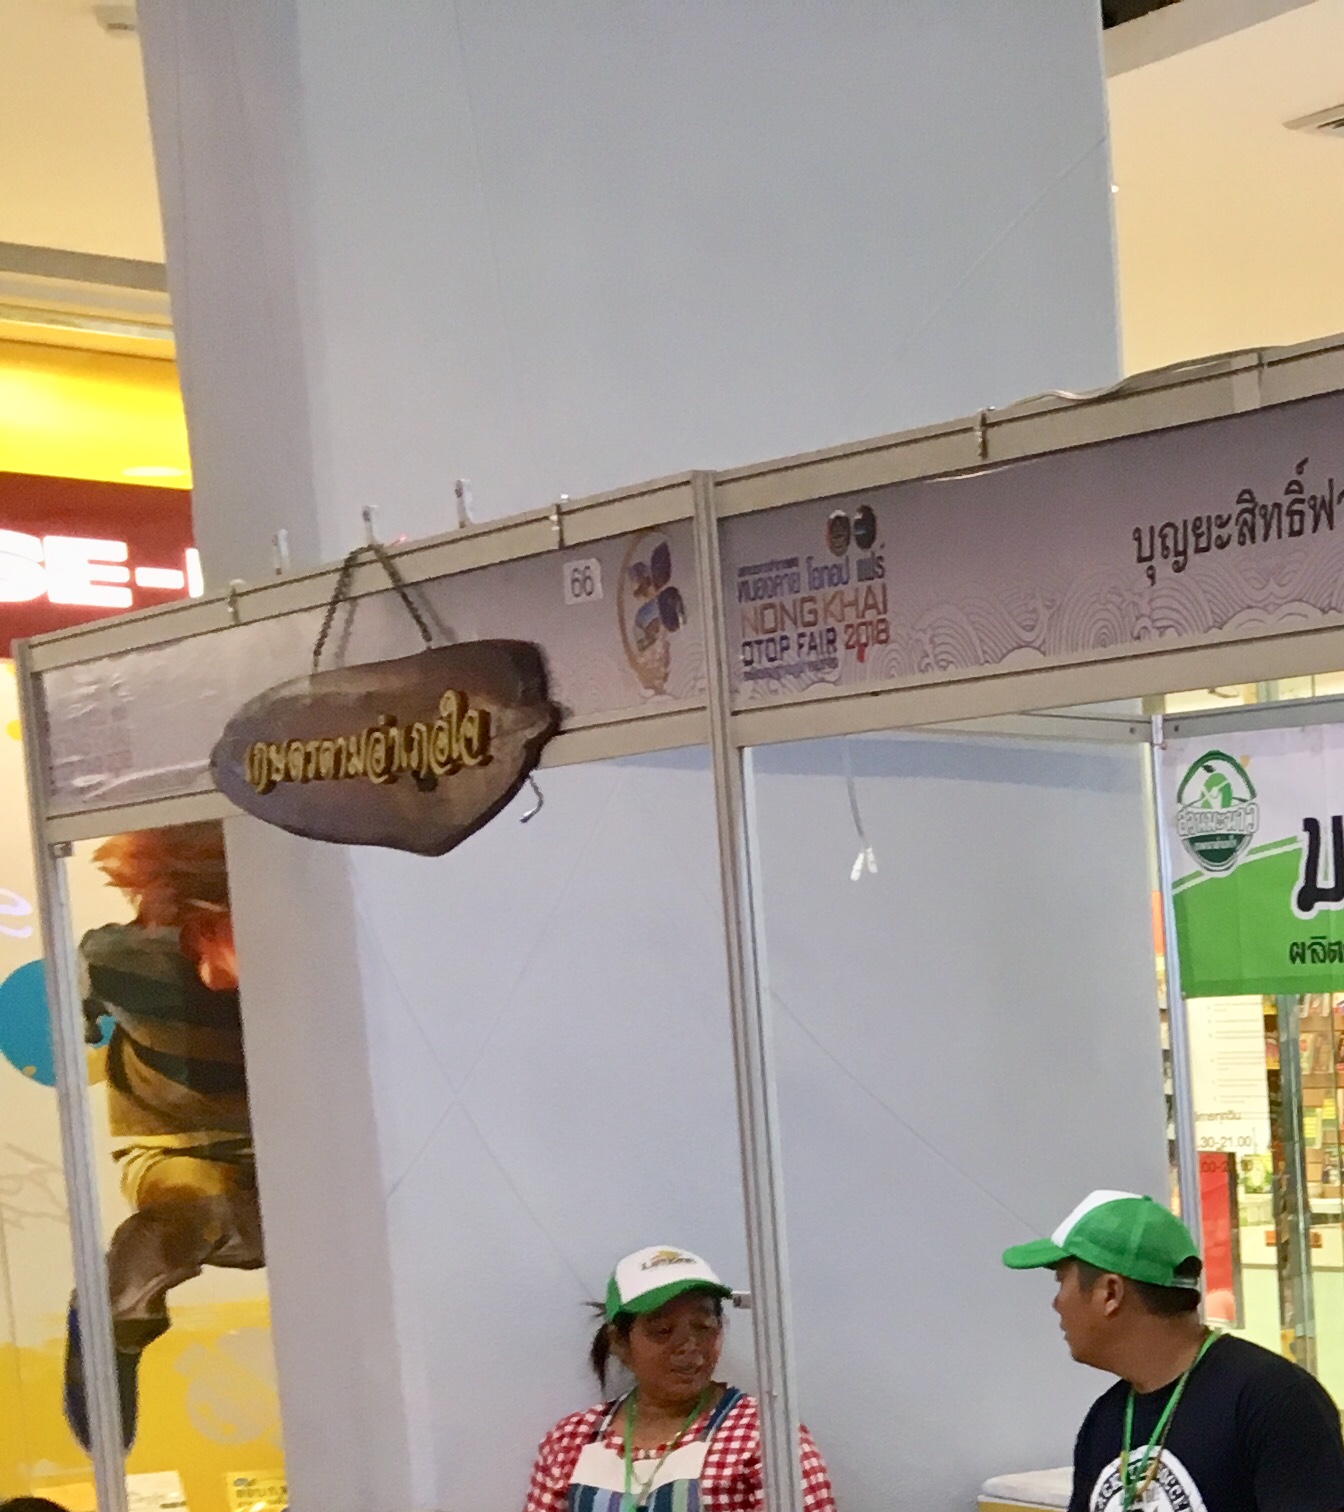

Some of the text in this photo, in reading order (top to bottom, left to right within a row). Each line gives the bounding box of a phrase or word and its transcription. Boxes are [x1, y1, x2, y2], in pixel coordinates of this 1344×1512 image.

[570, 565, 595, 598] 66
[806, 556, 849, 591] โอทอป
[855, 542, 886, 582] แฟร์
[741, 584, 889, 636] NONG KHAI
[741, 617, 891, 667] OTOP FAIR 2018
